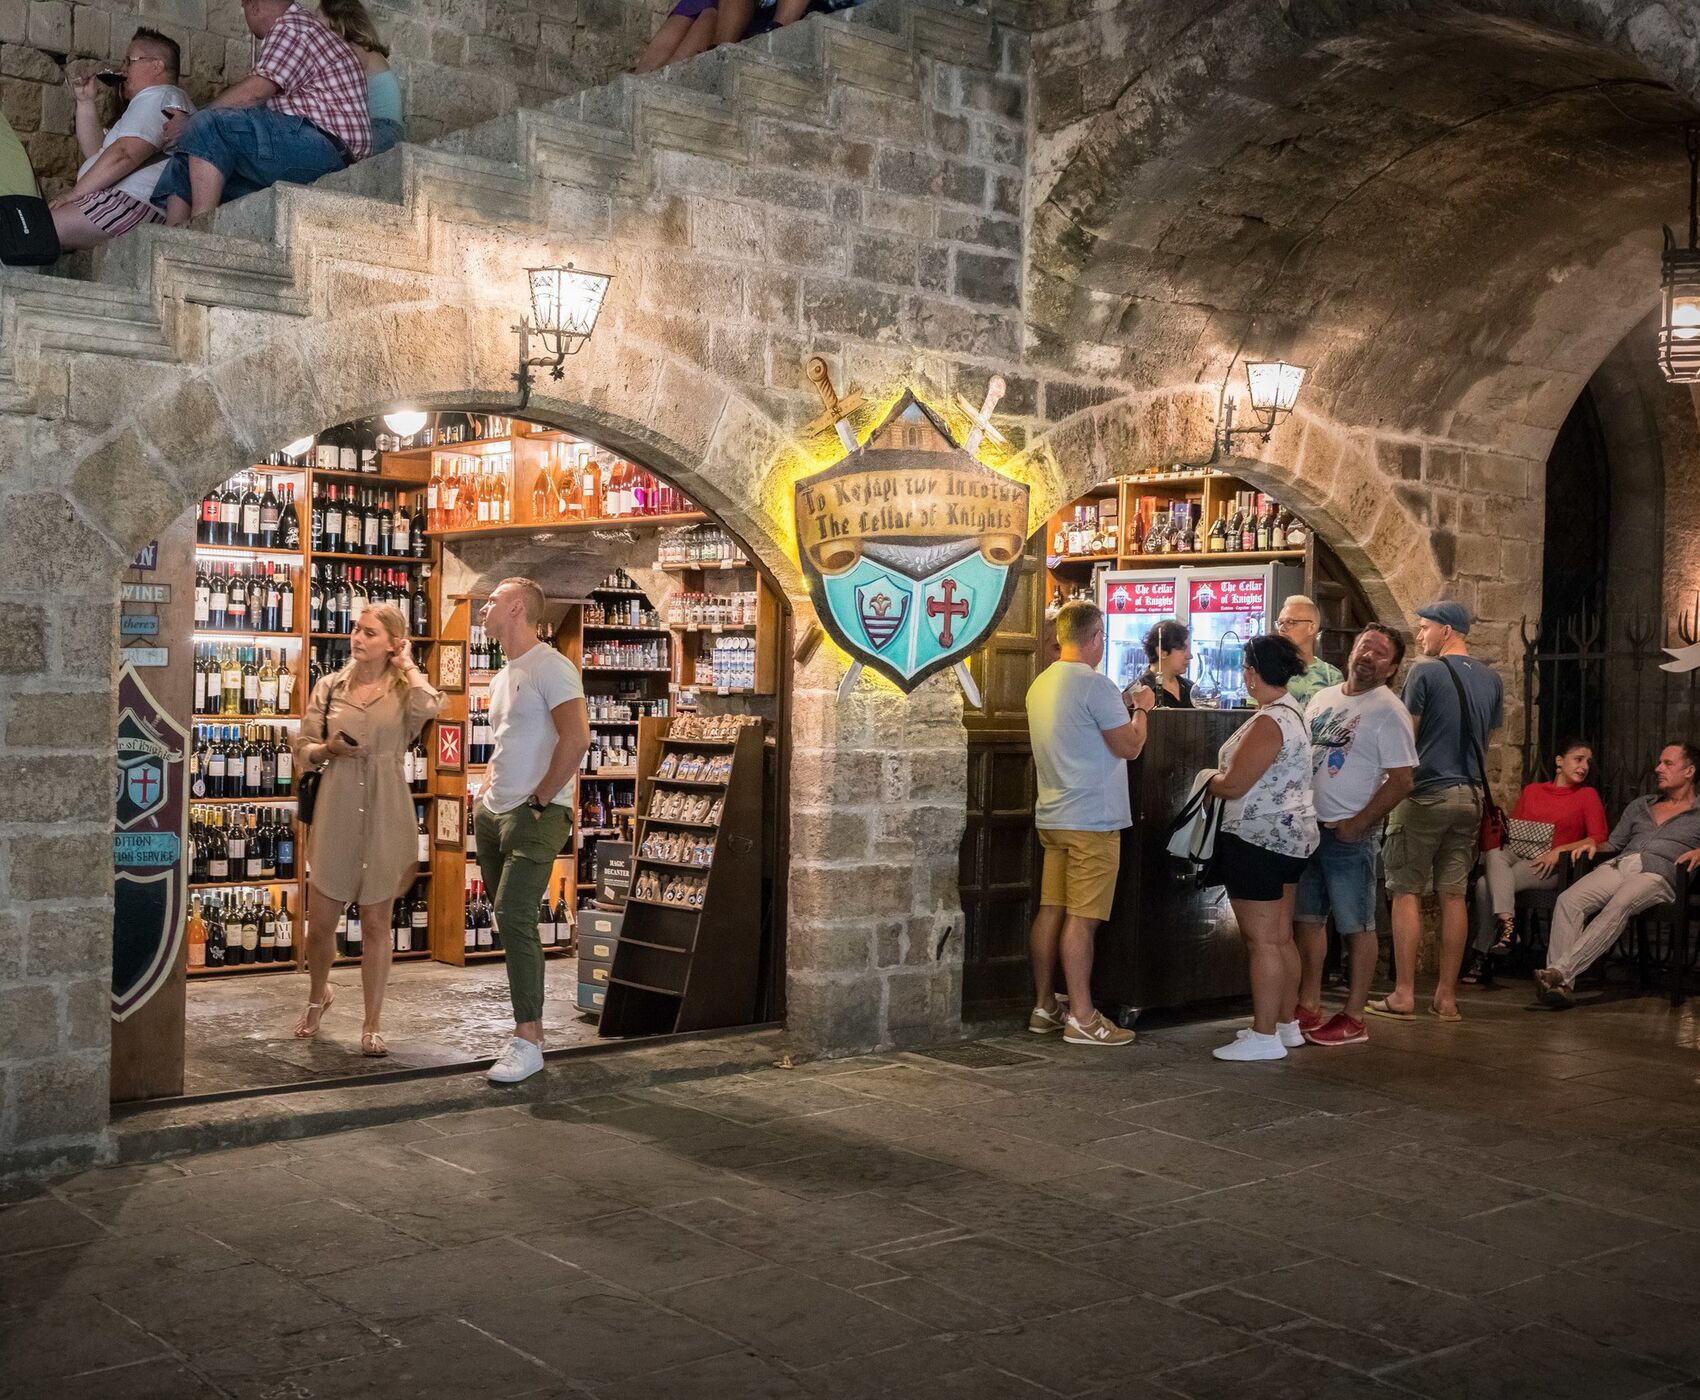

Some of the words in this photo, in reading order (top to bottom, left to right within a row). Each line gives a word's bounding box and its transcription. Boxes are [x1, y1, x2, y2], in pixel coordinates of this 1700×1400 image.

[815, 513, 850, 539] The
[859, 506, 913, 533] Cellar
[921, 503, 937, 527] of
[946, 502, 1011, 532] Knights
[1135, 584, 1150, 595] The
[1152, 583, 1174, 594] Cellar
[1221, 581, 1236, 593] The
[1239, 581, 1263, 591] Cellar
[121, 585, 165, 603] WINE
[1220, 594, 1228, 604] of
[1232, 593, 1262, 605] Knights
[1135, 596, 1142, 605] of
[1145, 595, 1173, 607] Knights
[123, 618, 156, 630] there's
[126, 738, 138, 750] of
[138, 739, 173, 761] Knights
[136, 851, 174, 862] SERVICE
